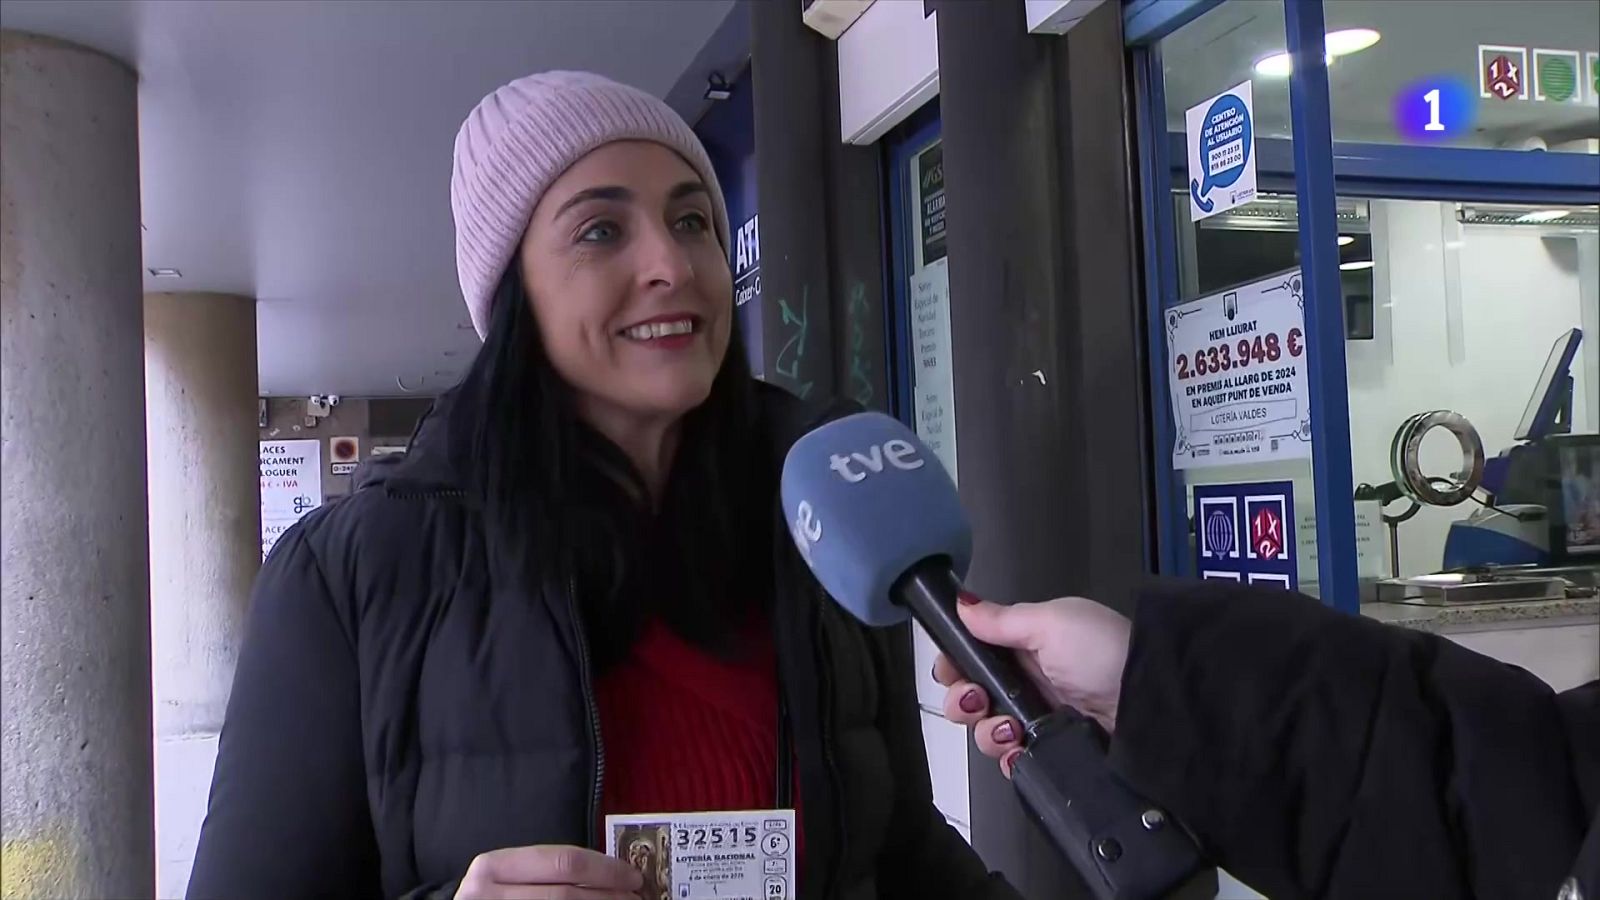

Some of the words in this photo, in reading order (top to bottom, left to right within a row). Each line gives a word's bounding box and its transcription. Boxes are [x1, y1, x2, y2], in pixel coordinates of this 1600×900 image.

[1212, 107, 1236, 124] CENTRO
[1205, 128, 1213, 138] DE
[1207, 137, 1216, 147] AL
[1216, 125, 1242, 143] USUARIO
[1209, 330, 1225, 341] HEM
[1226, 320, 1257, 337] LLIURAT
[1176, 332, 1281, 380] 2.633.948
[1287, 327, 1303, 357] €
[1186, 386, 1196, 396] EN
[1224, 377, 1234, 388] AL
[1234, 373, 1260, 387] LLARG
[1261, 370, 1273, 382] DE
[1275, 366, 1296, 379] 2024
[1192, 398, 1202, 408] EN
[1228, 389, 1248, 402] PUNT
[1249, 387, 1261, 399] DE
[1262, 381, 1292, 396] VENDA
[1211, 410, 1238, 425] LOTERÍA
[1239, 407, 1267, 421] VALDES
[829, 439, 925, 482] tve
[283, 480, 298, 488] IVA
[677, 827, 757, 846] 32515
[676, 854, 712, 863] LOTERÍA
[714, 852, 756, 861] NACIONAL
[769, 885, 782, 895] 20
